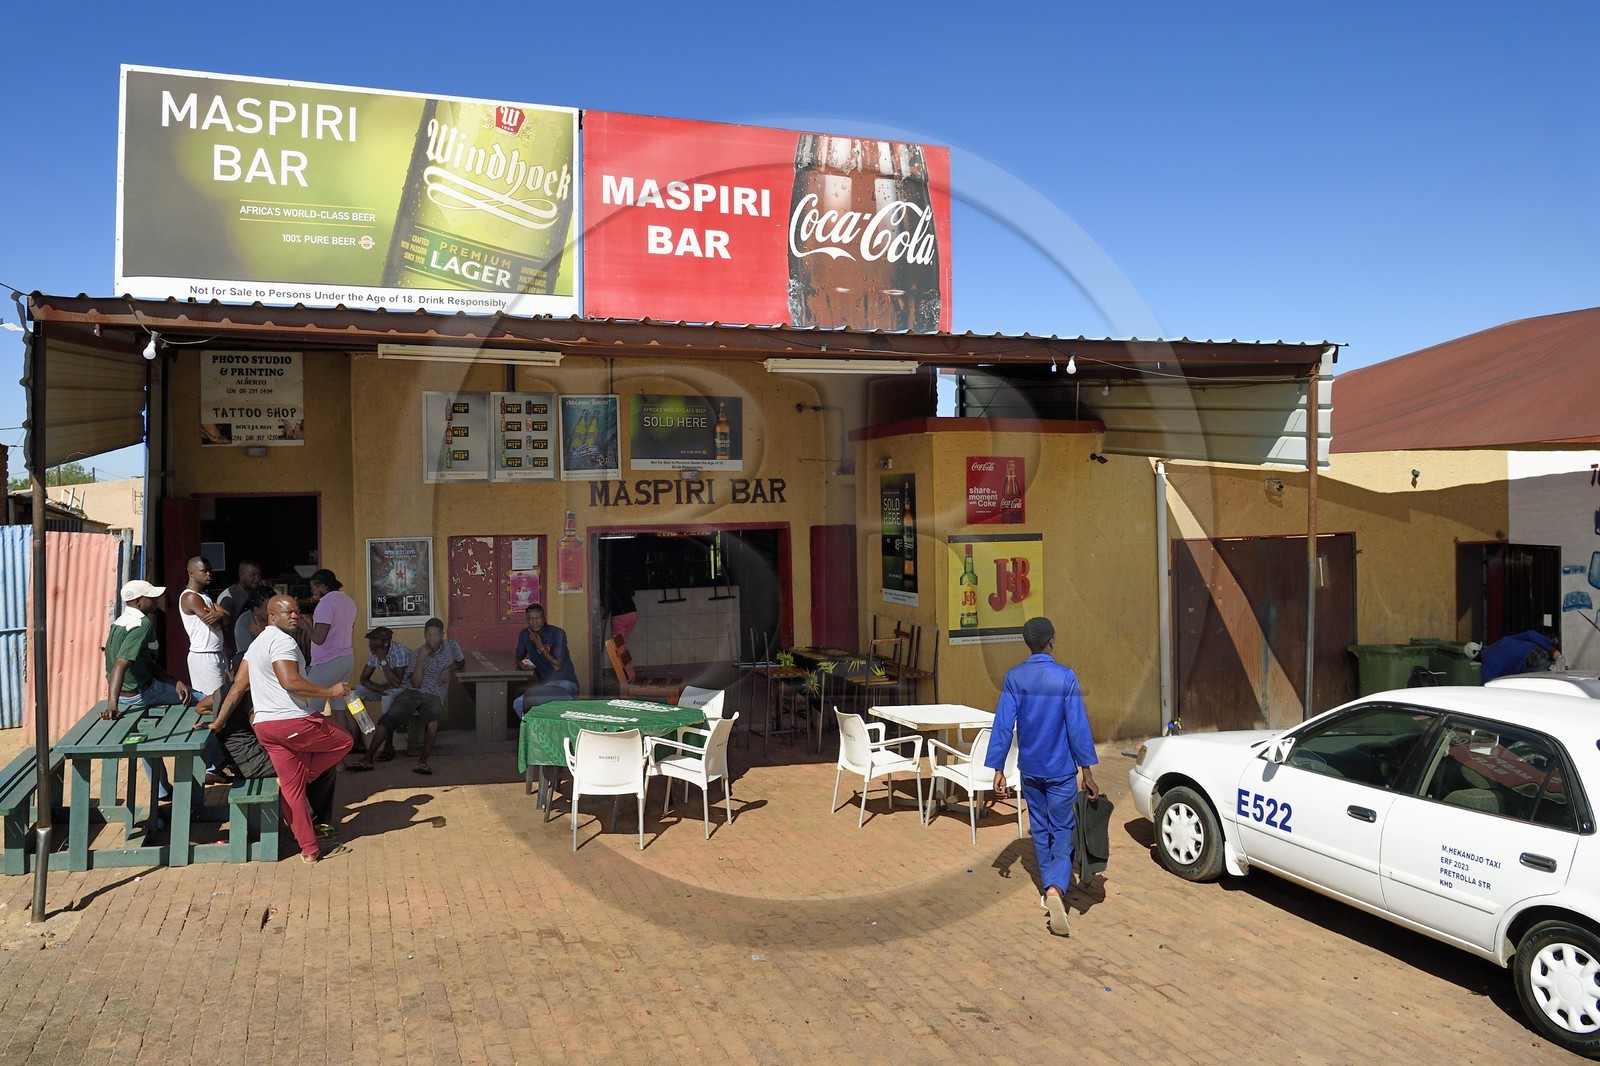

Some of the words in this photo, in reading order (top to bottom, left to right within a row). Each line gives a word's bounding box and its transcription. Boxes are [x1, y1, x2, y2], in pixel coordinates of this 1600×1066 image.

[161, 90, 357, 143] MASPIRI
[213, 144, 308, 187] BAR
[427, 118, 571, 201] Windhoek
[602, 174, 771, 218] MASPIRI
[240, 205, 281, 217] AFRICA'S
[283, 208, 350, 221] WORLD-CLASS
[352, 212, 376, 222] BEER
[788, 193, 935, 266] Coca-Cola
[282, 234, 302, 243] 100%
[304, 235, 330, 245] PURE
[332, 237, 356, 246] BEER
[647, 224, 732, 259] BAR
[439, 241, 512, 270] PREMIUM
[430, 250, 512, 289] LAGER
[189, 285, 208, 295] Not
[211, 286, 227, 296] for
[230, 287, 252, 297] Sale
[255, 288, 266, 298] to
[269, 289, 311, 299] Persons
[314, 291, 346, 301] Under
[348, 293, 364, 302] the
[366, 293, 386, 304] Age
[388, 294, 399, 303] of
[402, 295, 416, 304] 18.
[418, 295, 445, 305] Drink
[447, 296, 509, 308] Responsibly.
[212, 355, 249, 364] PHOTO
[251, 355, 292, 365] STUDIO
[219, 367, 228, 376] &
[231, 367, 284, 377] PRINTING
[212, 407, 262, 418] TATTOO
[267, 407, 297, 418] SHOP
[643, 416, 674, 428] SOLD
[677, 416, 707, 428] HERE
[588, 478, 716, 507] MASPIRI
[729, 478, 787, 504] BAR
[969, 486, 991, 494] share
[883, 497, 901, 512] SOLD
[978, 499, 997, 507] Coke
[883, 512, 902, 526] HERE
[377, 596, 387, 604] N$
[1237, 788, 1292, 833] E522
[1440, 856, 1452, 866] ERF
[1454, 860, 1469, 872] 2023
[1441, 844, 1484, 865] M.HEKANDJO
[1485, 858, 1501, 869] TAXI
[1439, 867, 1477, 885] PRETROLLA
[1478, 879, 1492, 890] STR
[1439, 878, 1453, 889] KHD
